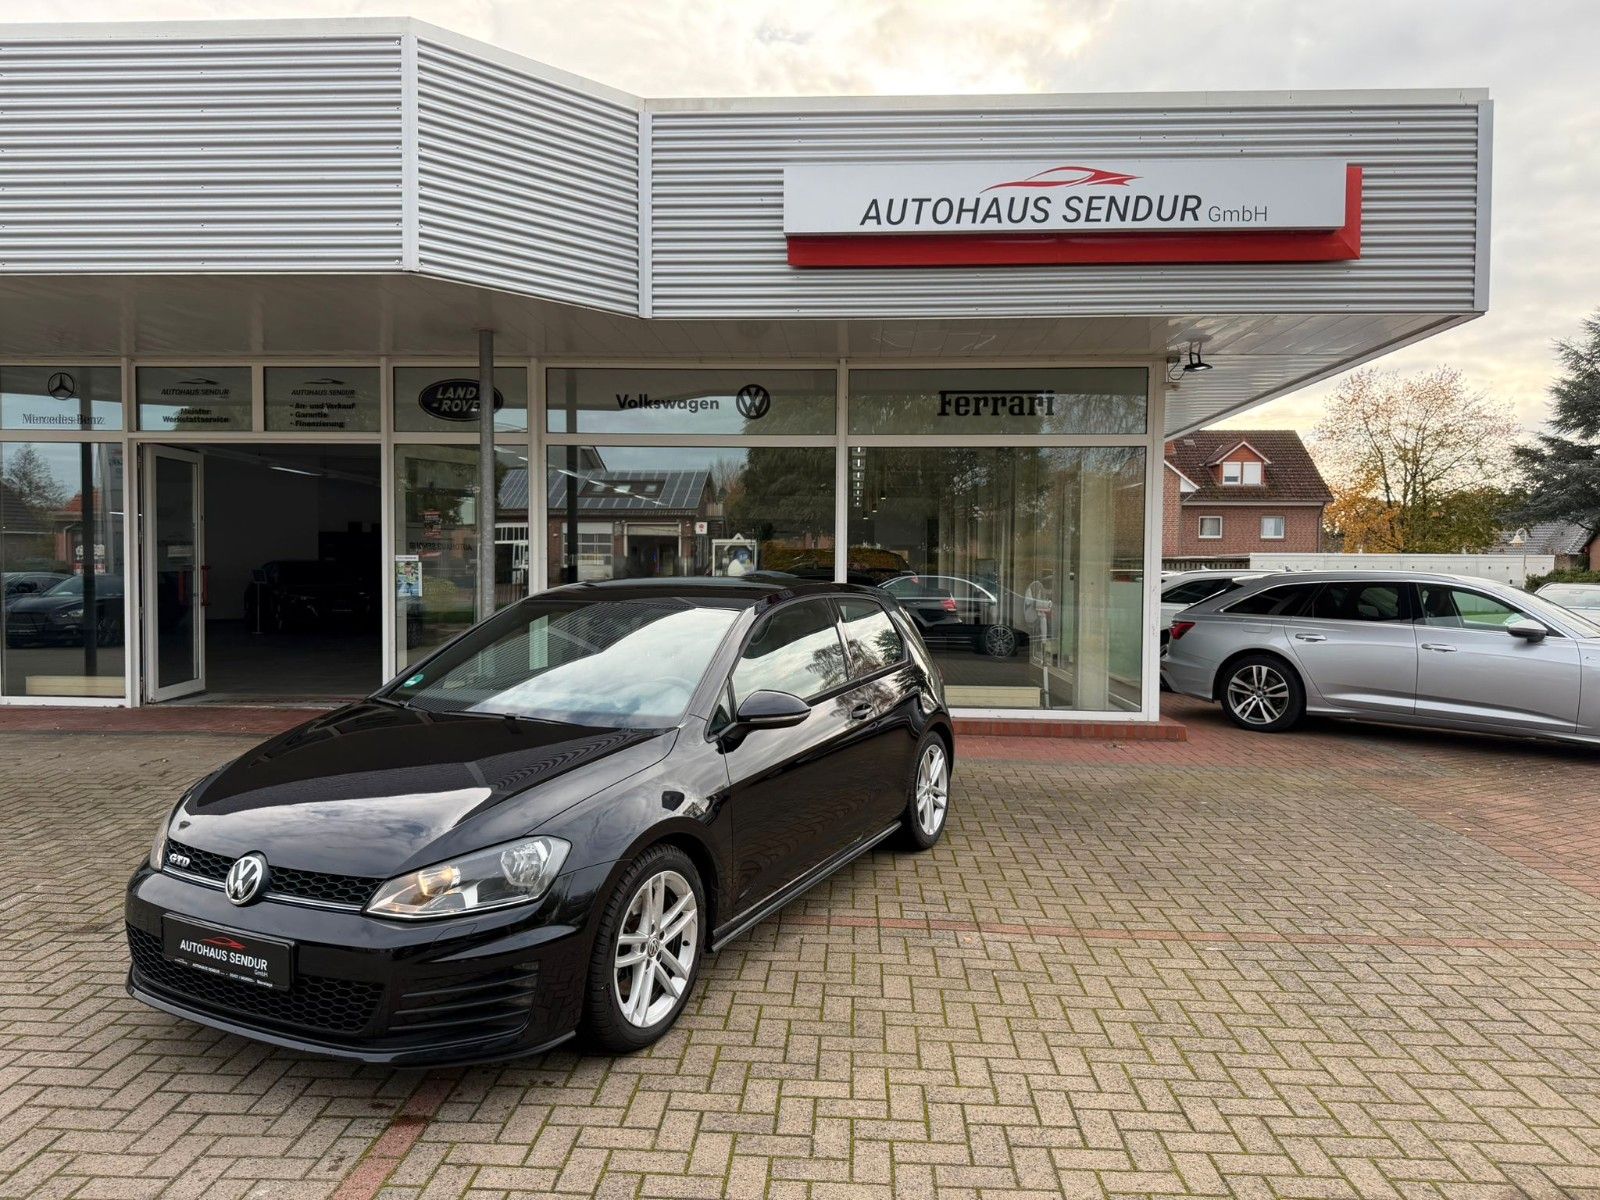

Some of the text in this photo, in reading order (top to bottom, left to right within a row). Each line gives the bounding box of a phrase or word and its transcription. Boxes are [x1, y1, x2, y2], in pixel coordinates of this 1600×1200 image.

[859, 194, 1268, 226] AUTOHAUS SENDUR GmbH
[161, 388, 230, 396] AUTOHAUS SENDUR
[436, 386, 476, 399] LAND
[616, 393, 720, 413] Volkswagen
[937, 390, 1055, 416] Ferrari
[21, 412, 105, 425] Mercedes-Benz
[295, 410, 329, 418] Garantie
[295, 420, 346, 428] Finanzierung
[168, 853, 191, 868] GTD
[180, 939, 228, 962] AUTOHAUS
[229, 952, 268, 972] SENDUR
